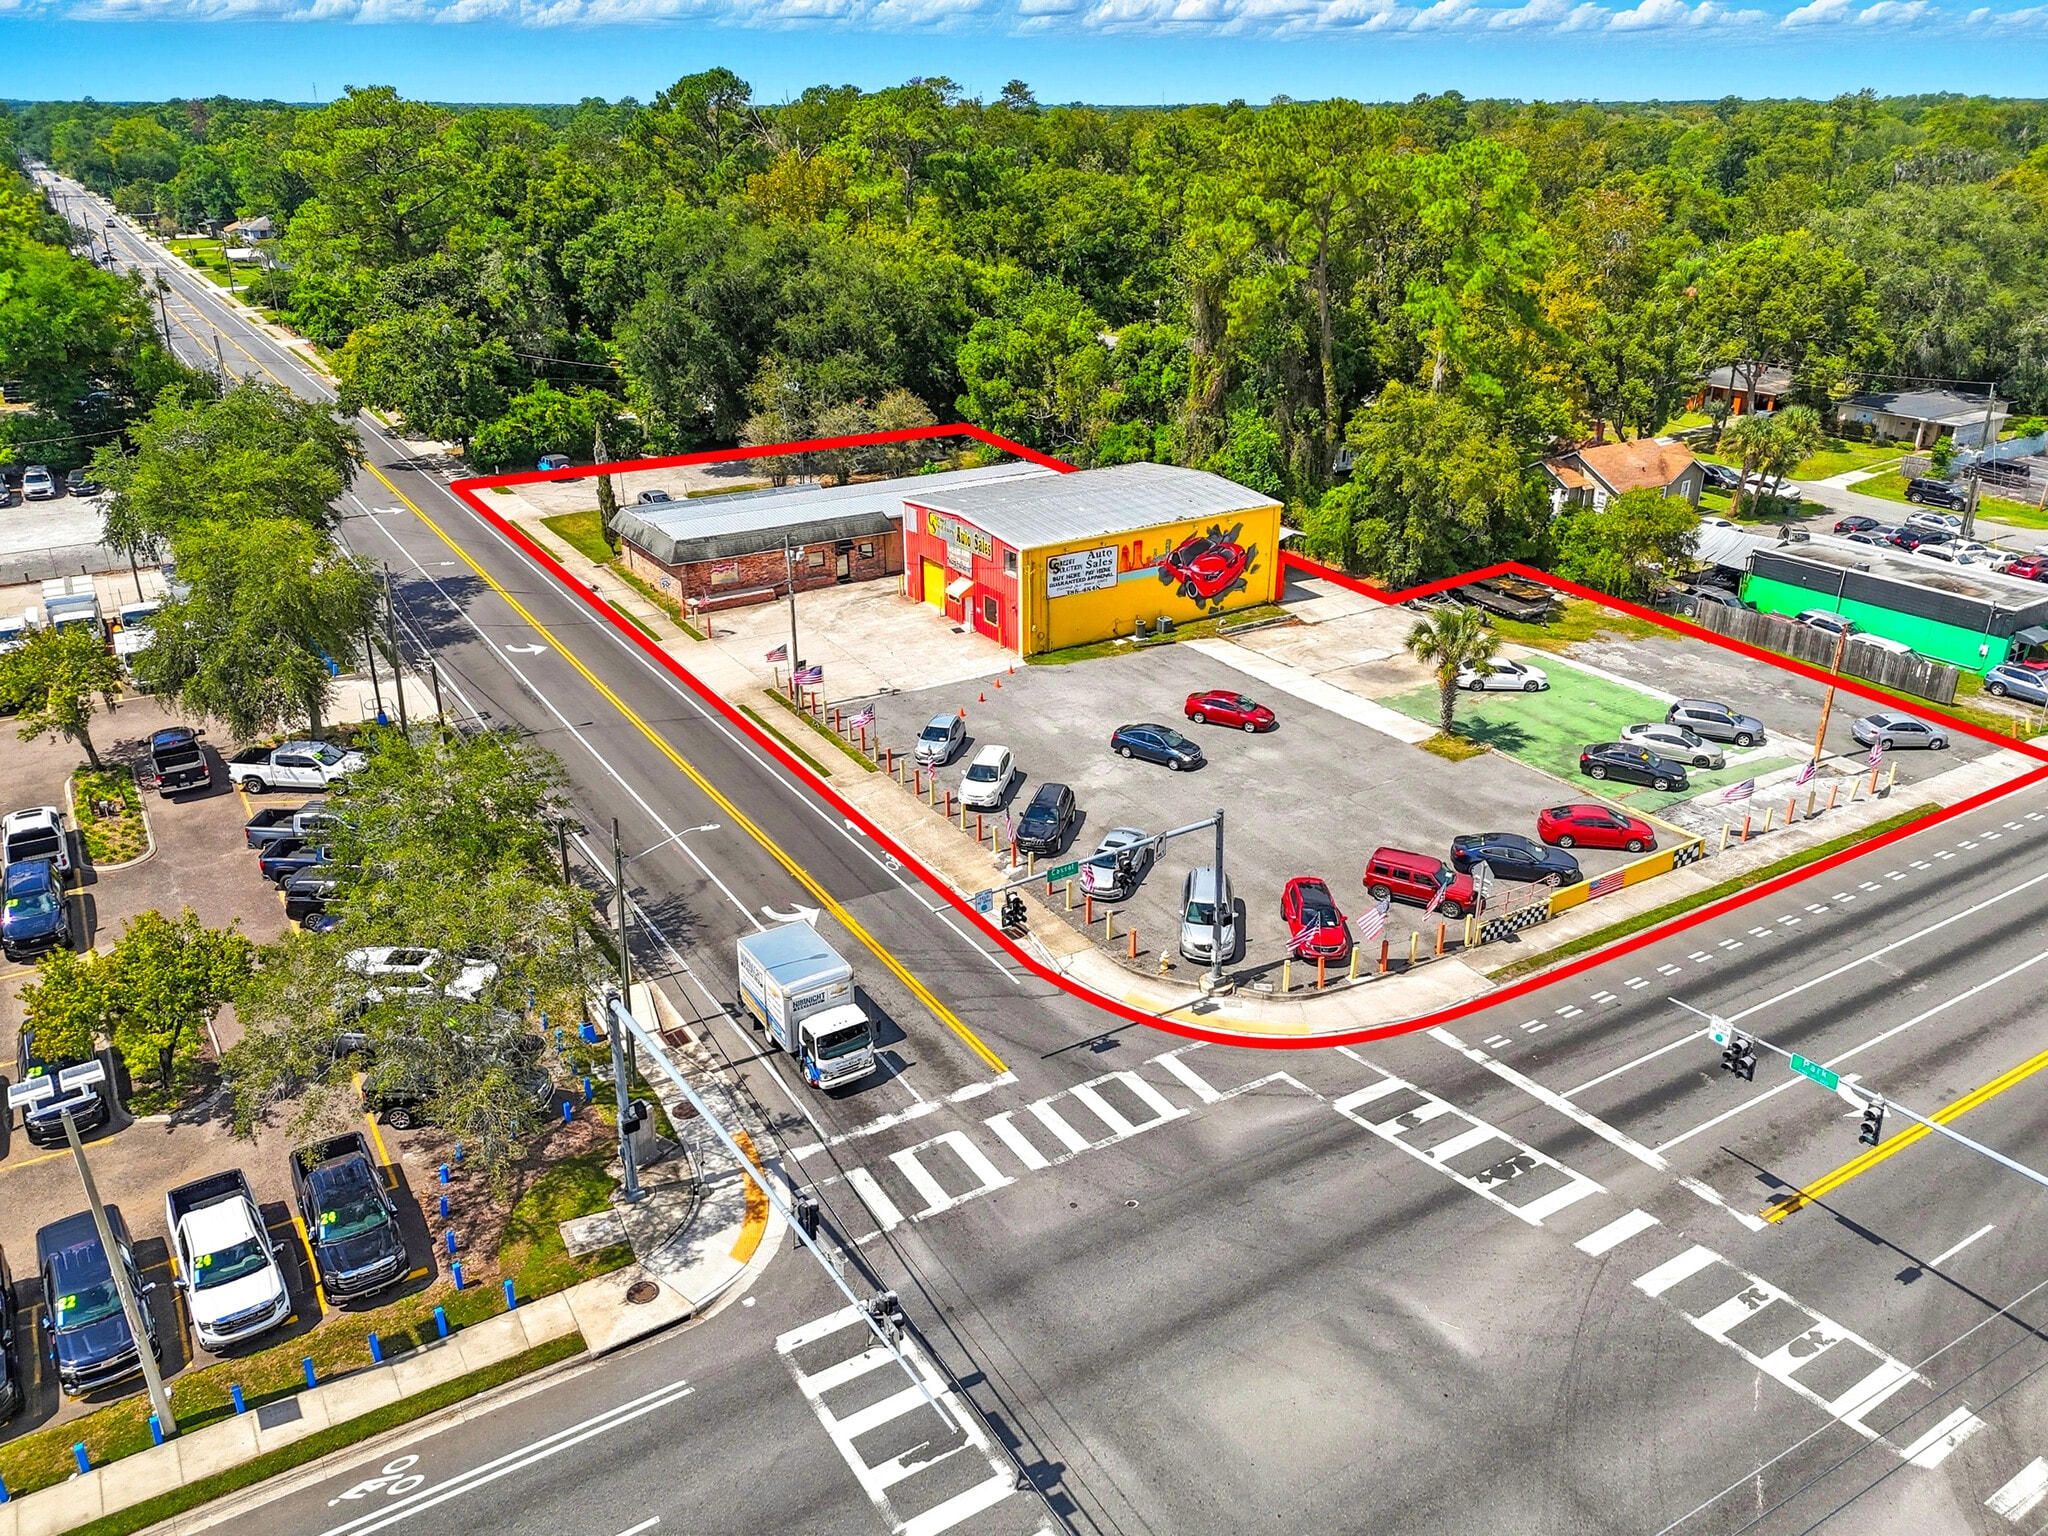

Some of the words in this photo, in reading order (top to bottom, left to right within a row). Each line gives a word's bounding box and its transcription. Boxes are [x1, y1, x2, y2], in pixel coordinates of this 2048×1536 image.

[974, 533, 991, 556] Sales
[1088, 549, 1112, 560] Auto
[1086, 558, 1112, 569] Sales
[1802, 1060, 1827, 1079] Park
